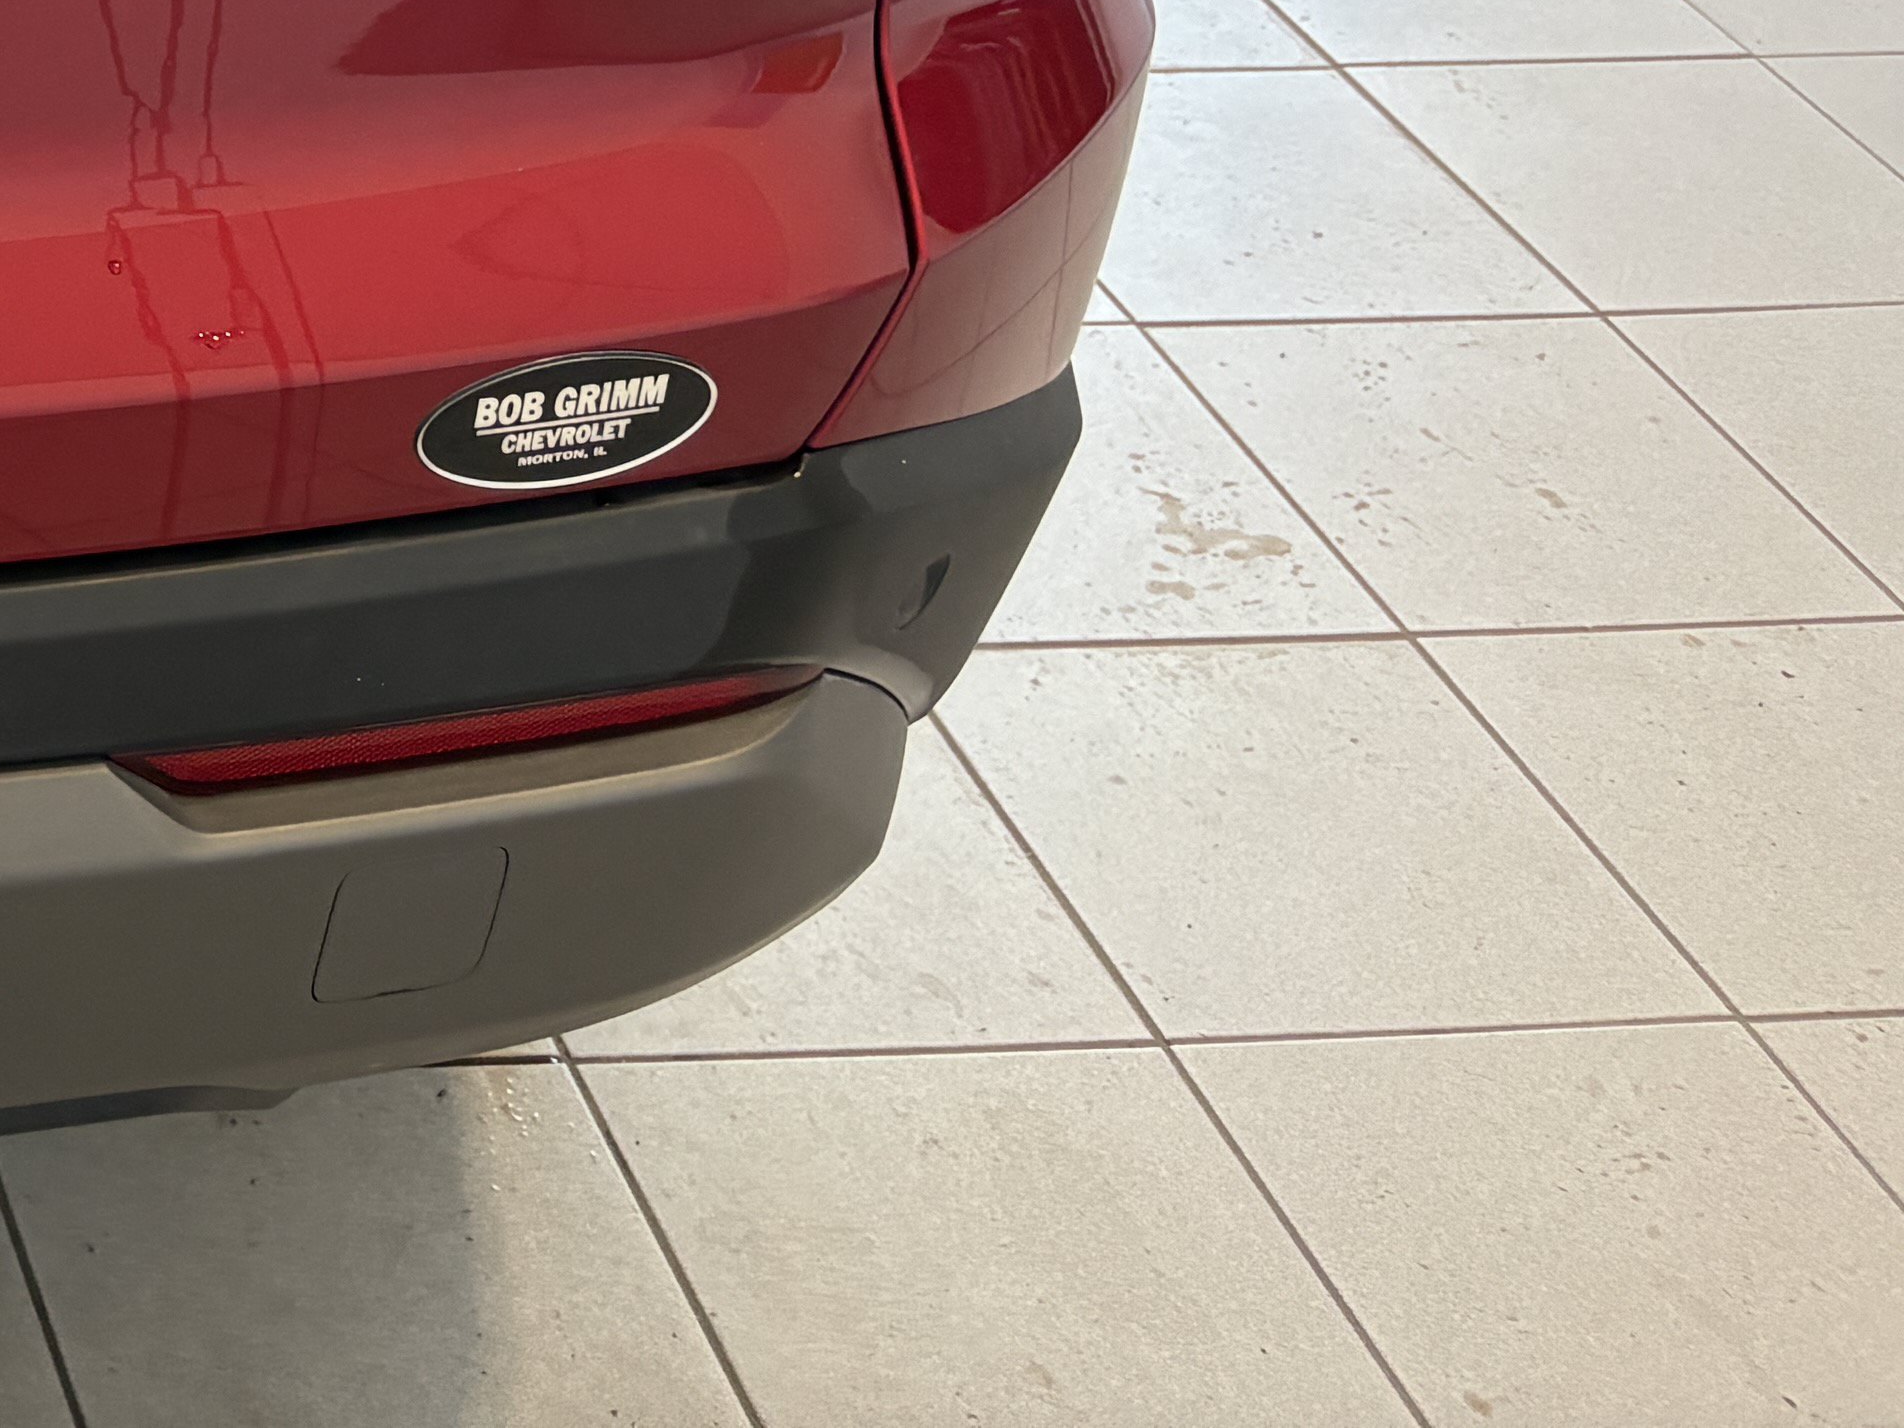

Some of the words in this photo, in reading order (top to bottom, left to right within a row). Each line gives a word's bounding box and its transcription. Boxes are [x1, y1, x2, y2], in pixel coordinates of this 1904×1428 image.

[474, 391, 546, 429] BOB
[554, 373, 670, 418] GRIMM
[501, 418, 632, 454] CHEVROLET
